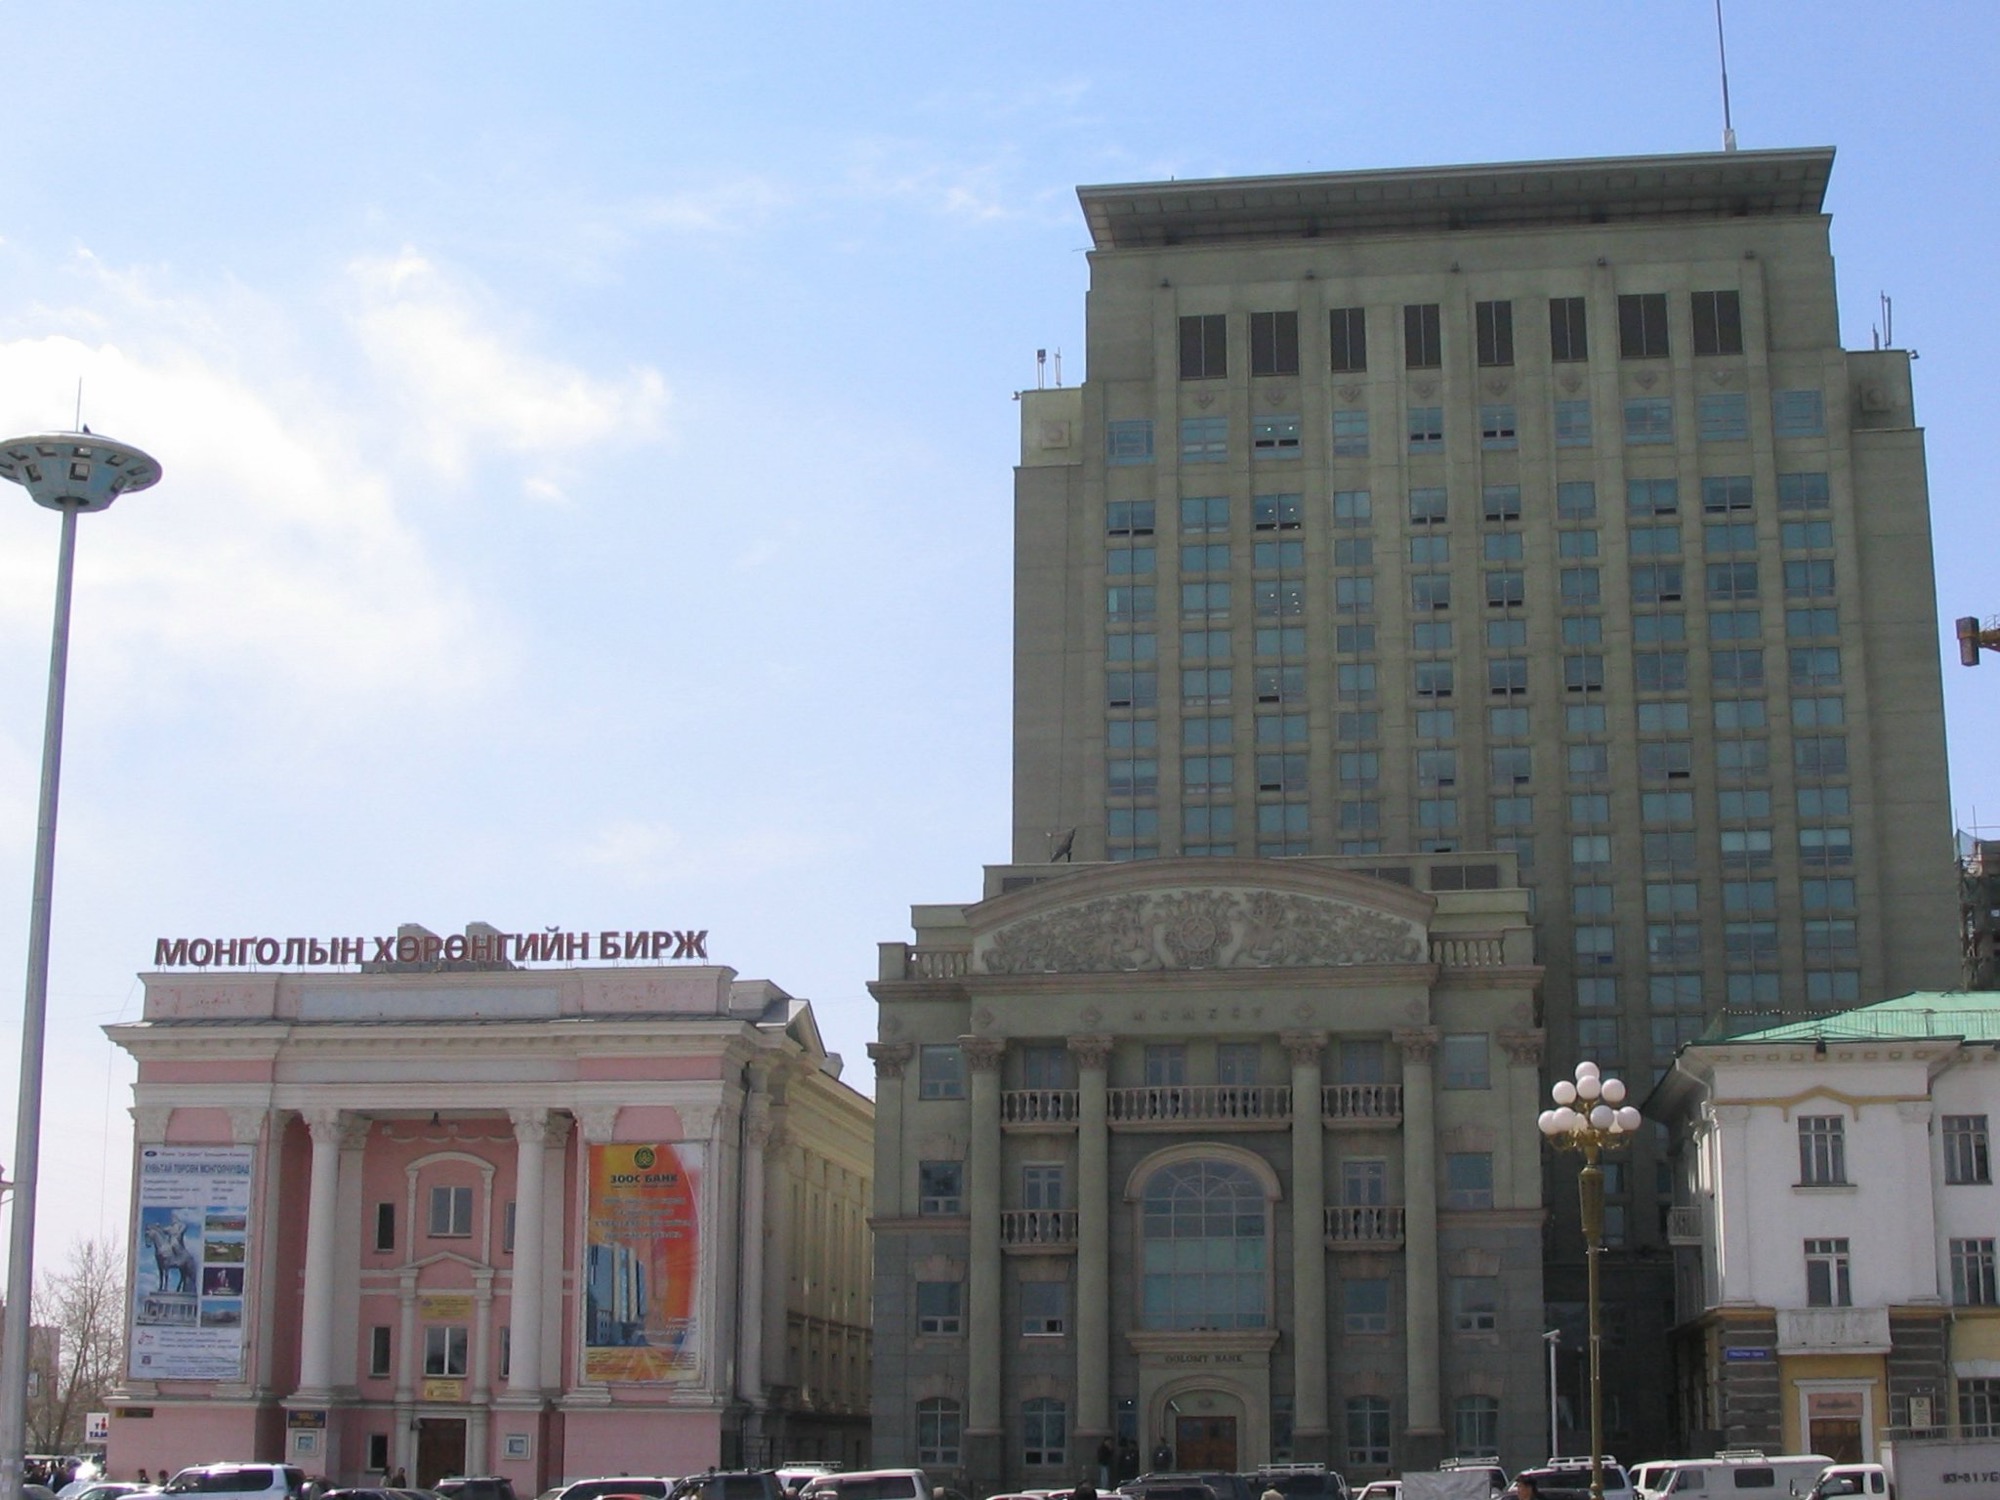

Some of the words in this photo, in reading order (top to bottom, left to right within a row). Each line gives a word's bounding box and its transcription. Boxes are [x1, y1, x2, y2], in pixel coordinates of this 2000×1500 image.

[154, 936, 364, 966] МОНГОЛЫН
[372, 926, 589, 963] ХӨРӨНГИЙН
[600, 930, 708, 960] БИРЖ
[610, 1174, 641, 1184] ЗООС
[645, 1174, 679, 1183] БАНК
